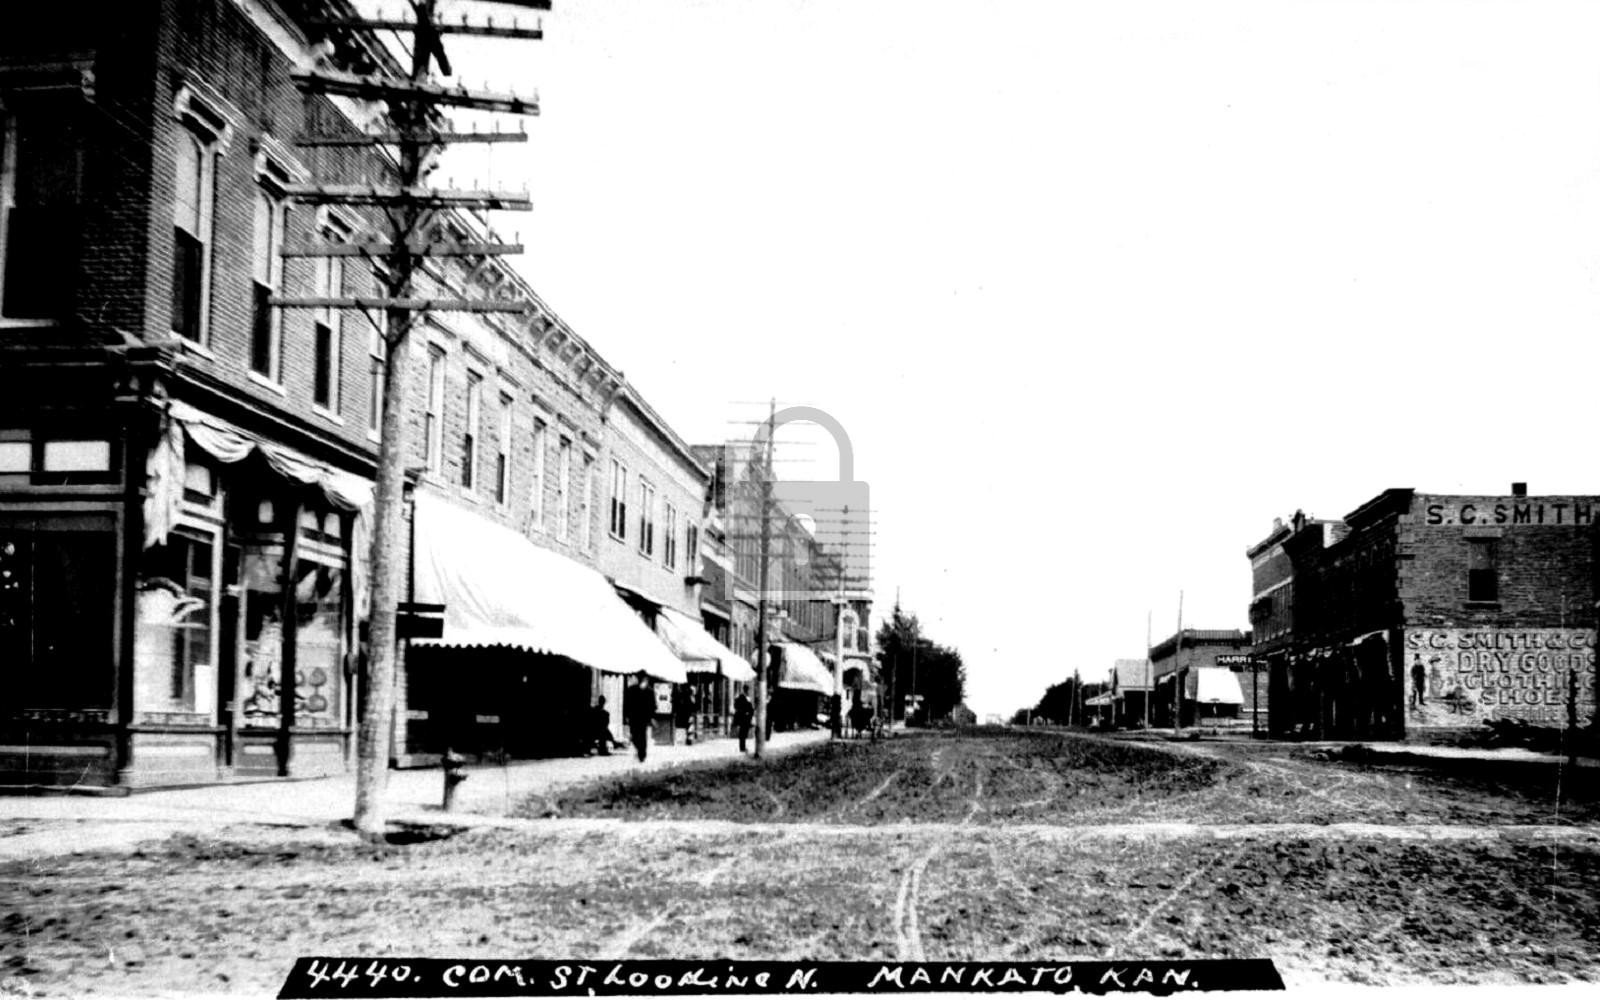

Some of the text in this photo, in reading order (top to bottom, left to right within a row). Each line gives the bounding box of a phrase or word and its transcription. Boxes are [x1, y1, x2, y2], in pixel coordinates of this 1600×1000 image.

[1494, 503, 1593, 524] SMITH
[1457, 631, 1543, 650] SMITH
[1457, 651, 1514, 674] DRY
